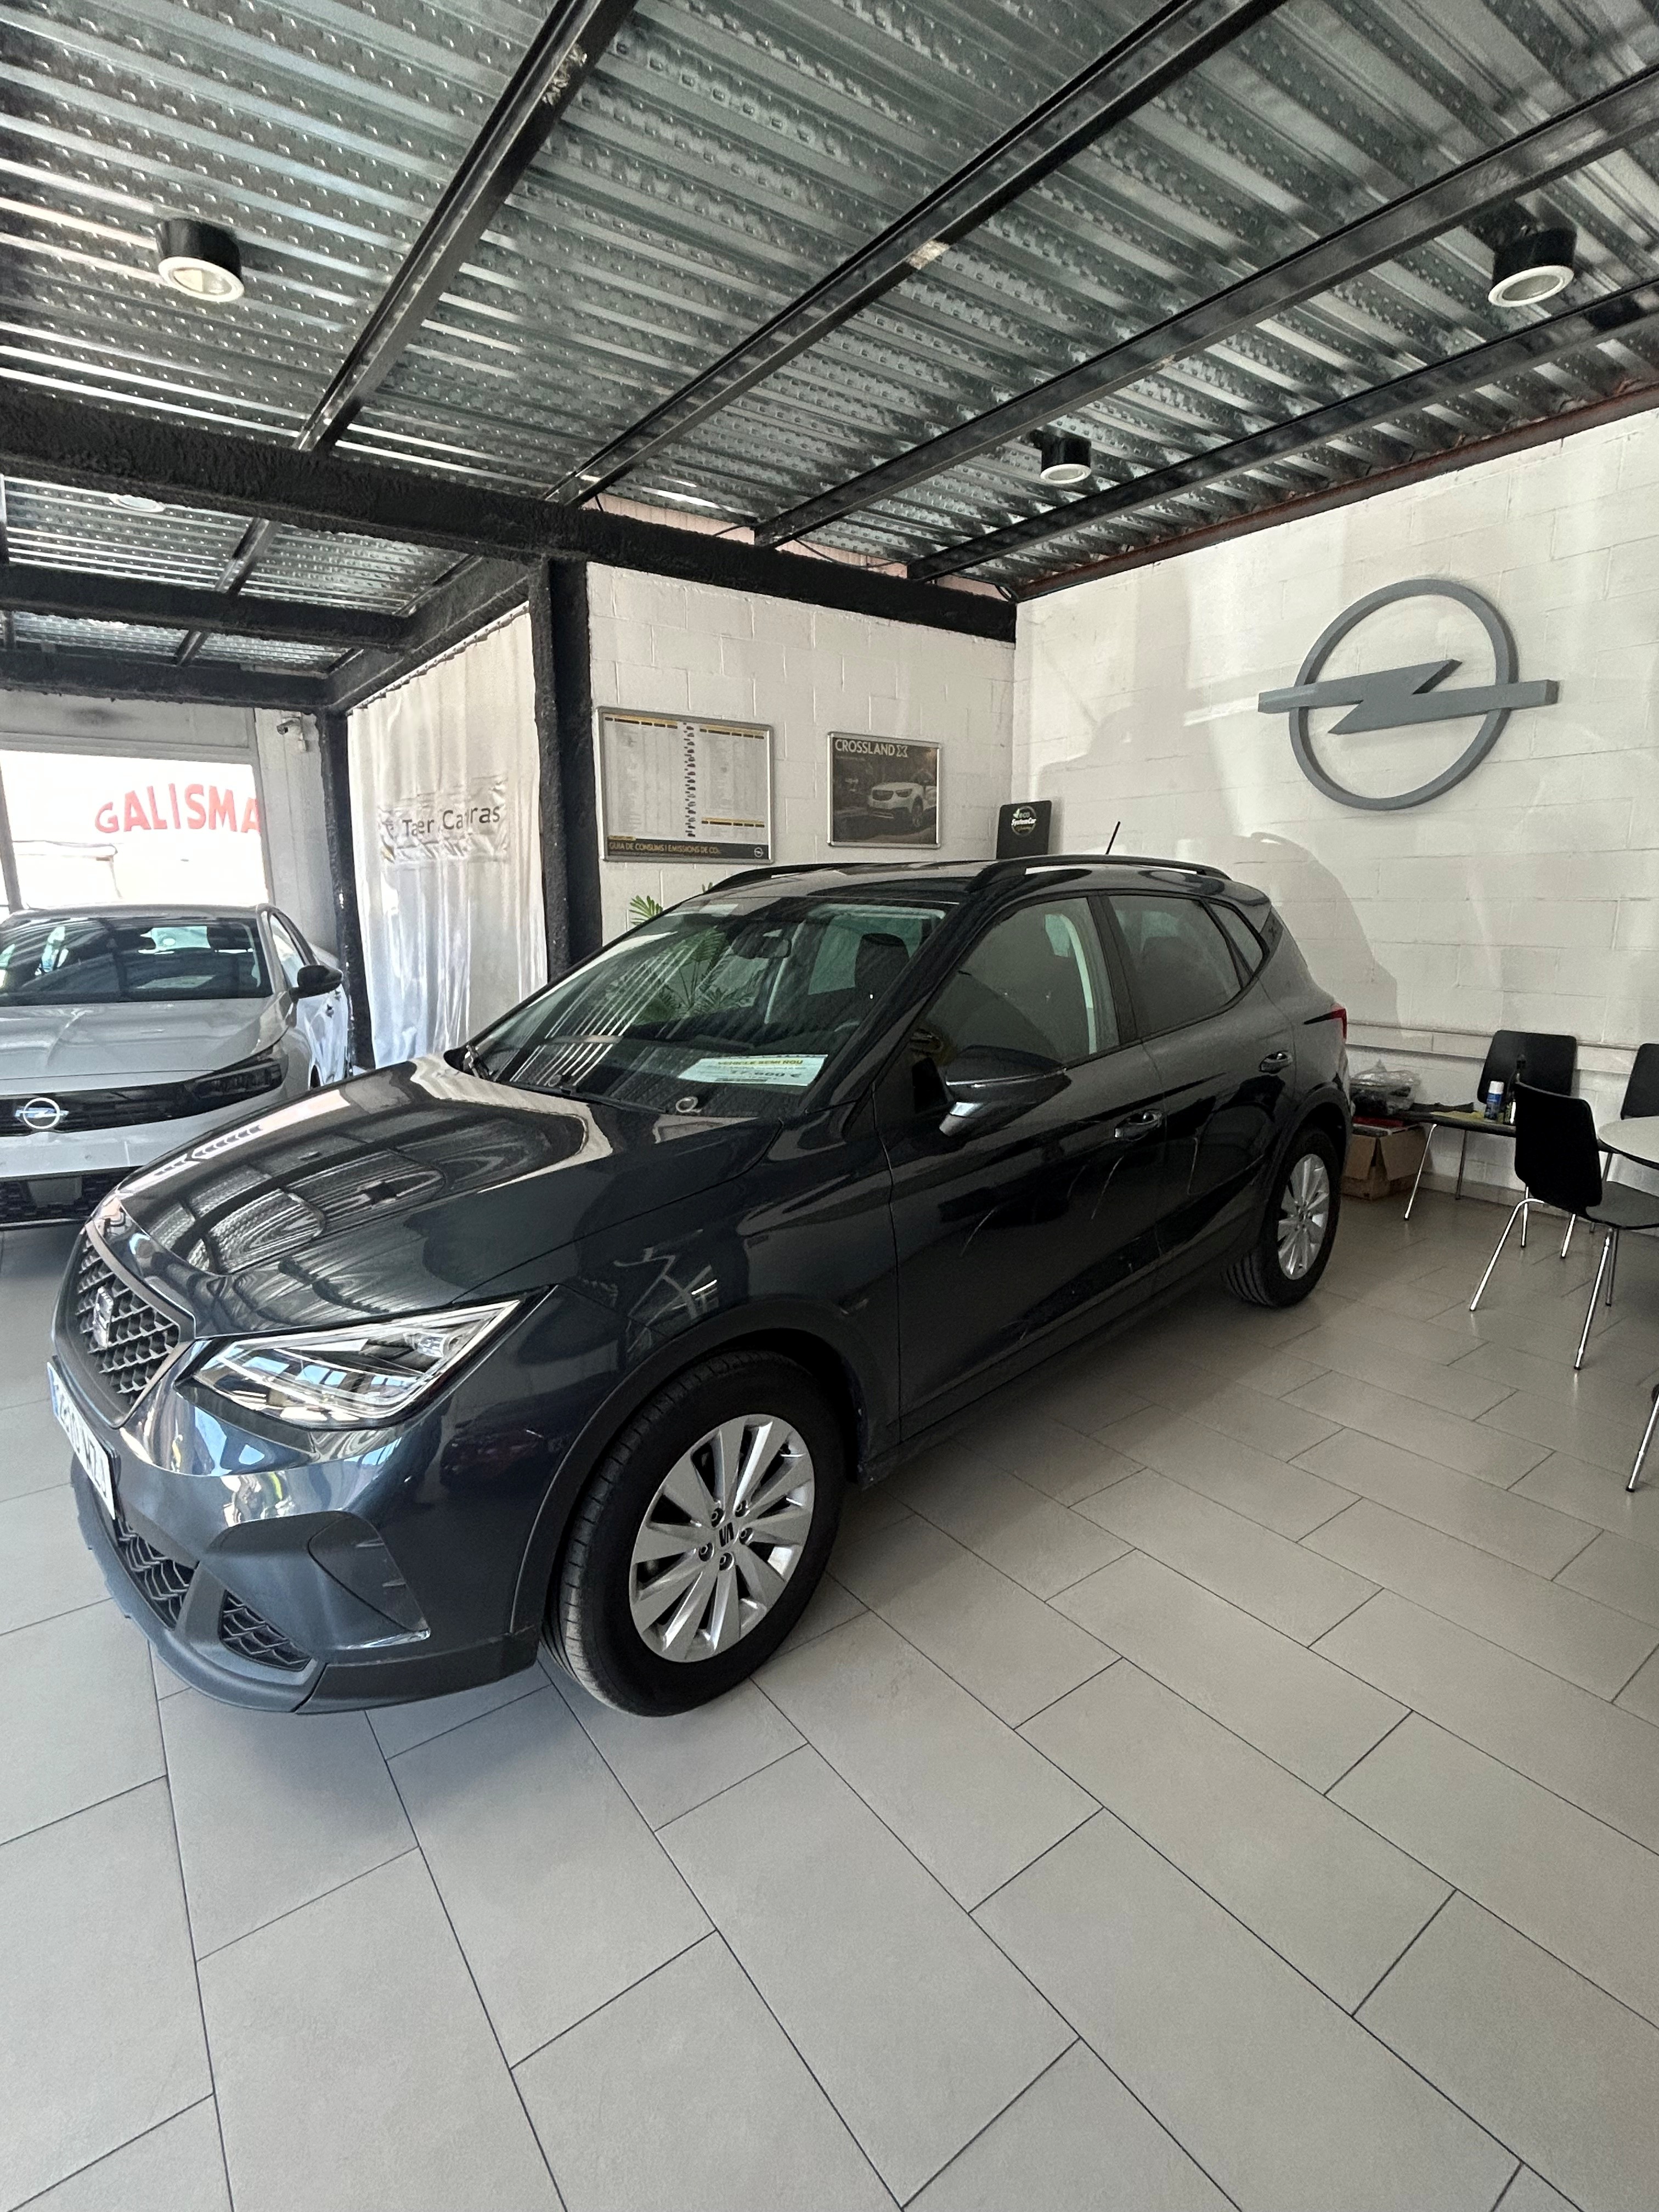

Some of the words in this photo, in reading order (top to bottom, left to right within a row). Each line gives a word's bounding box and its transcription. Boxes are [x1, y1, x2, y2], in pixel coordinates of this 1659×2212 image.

[835, 738, 895, 756] CROSSLAND
[896, 744, 908, 758] X
[95, 783, 261, 833] GALISMA
[635, 843, 664, 851] CONSUMS
[668, 844, 699, 853] EMISSIONS
